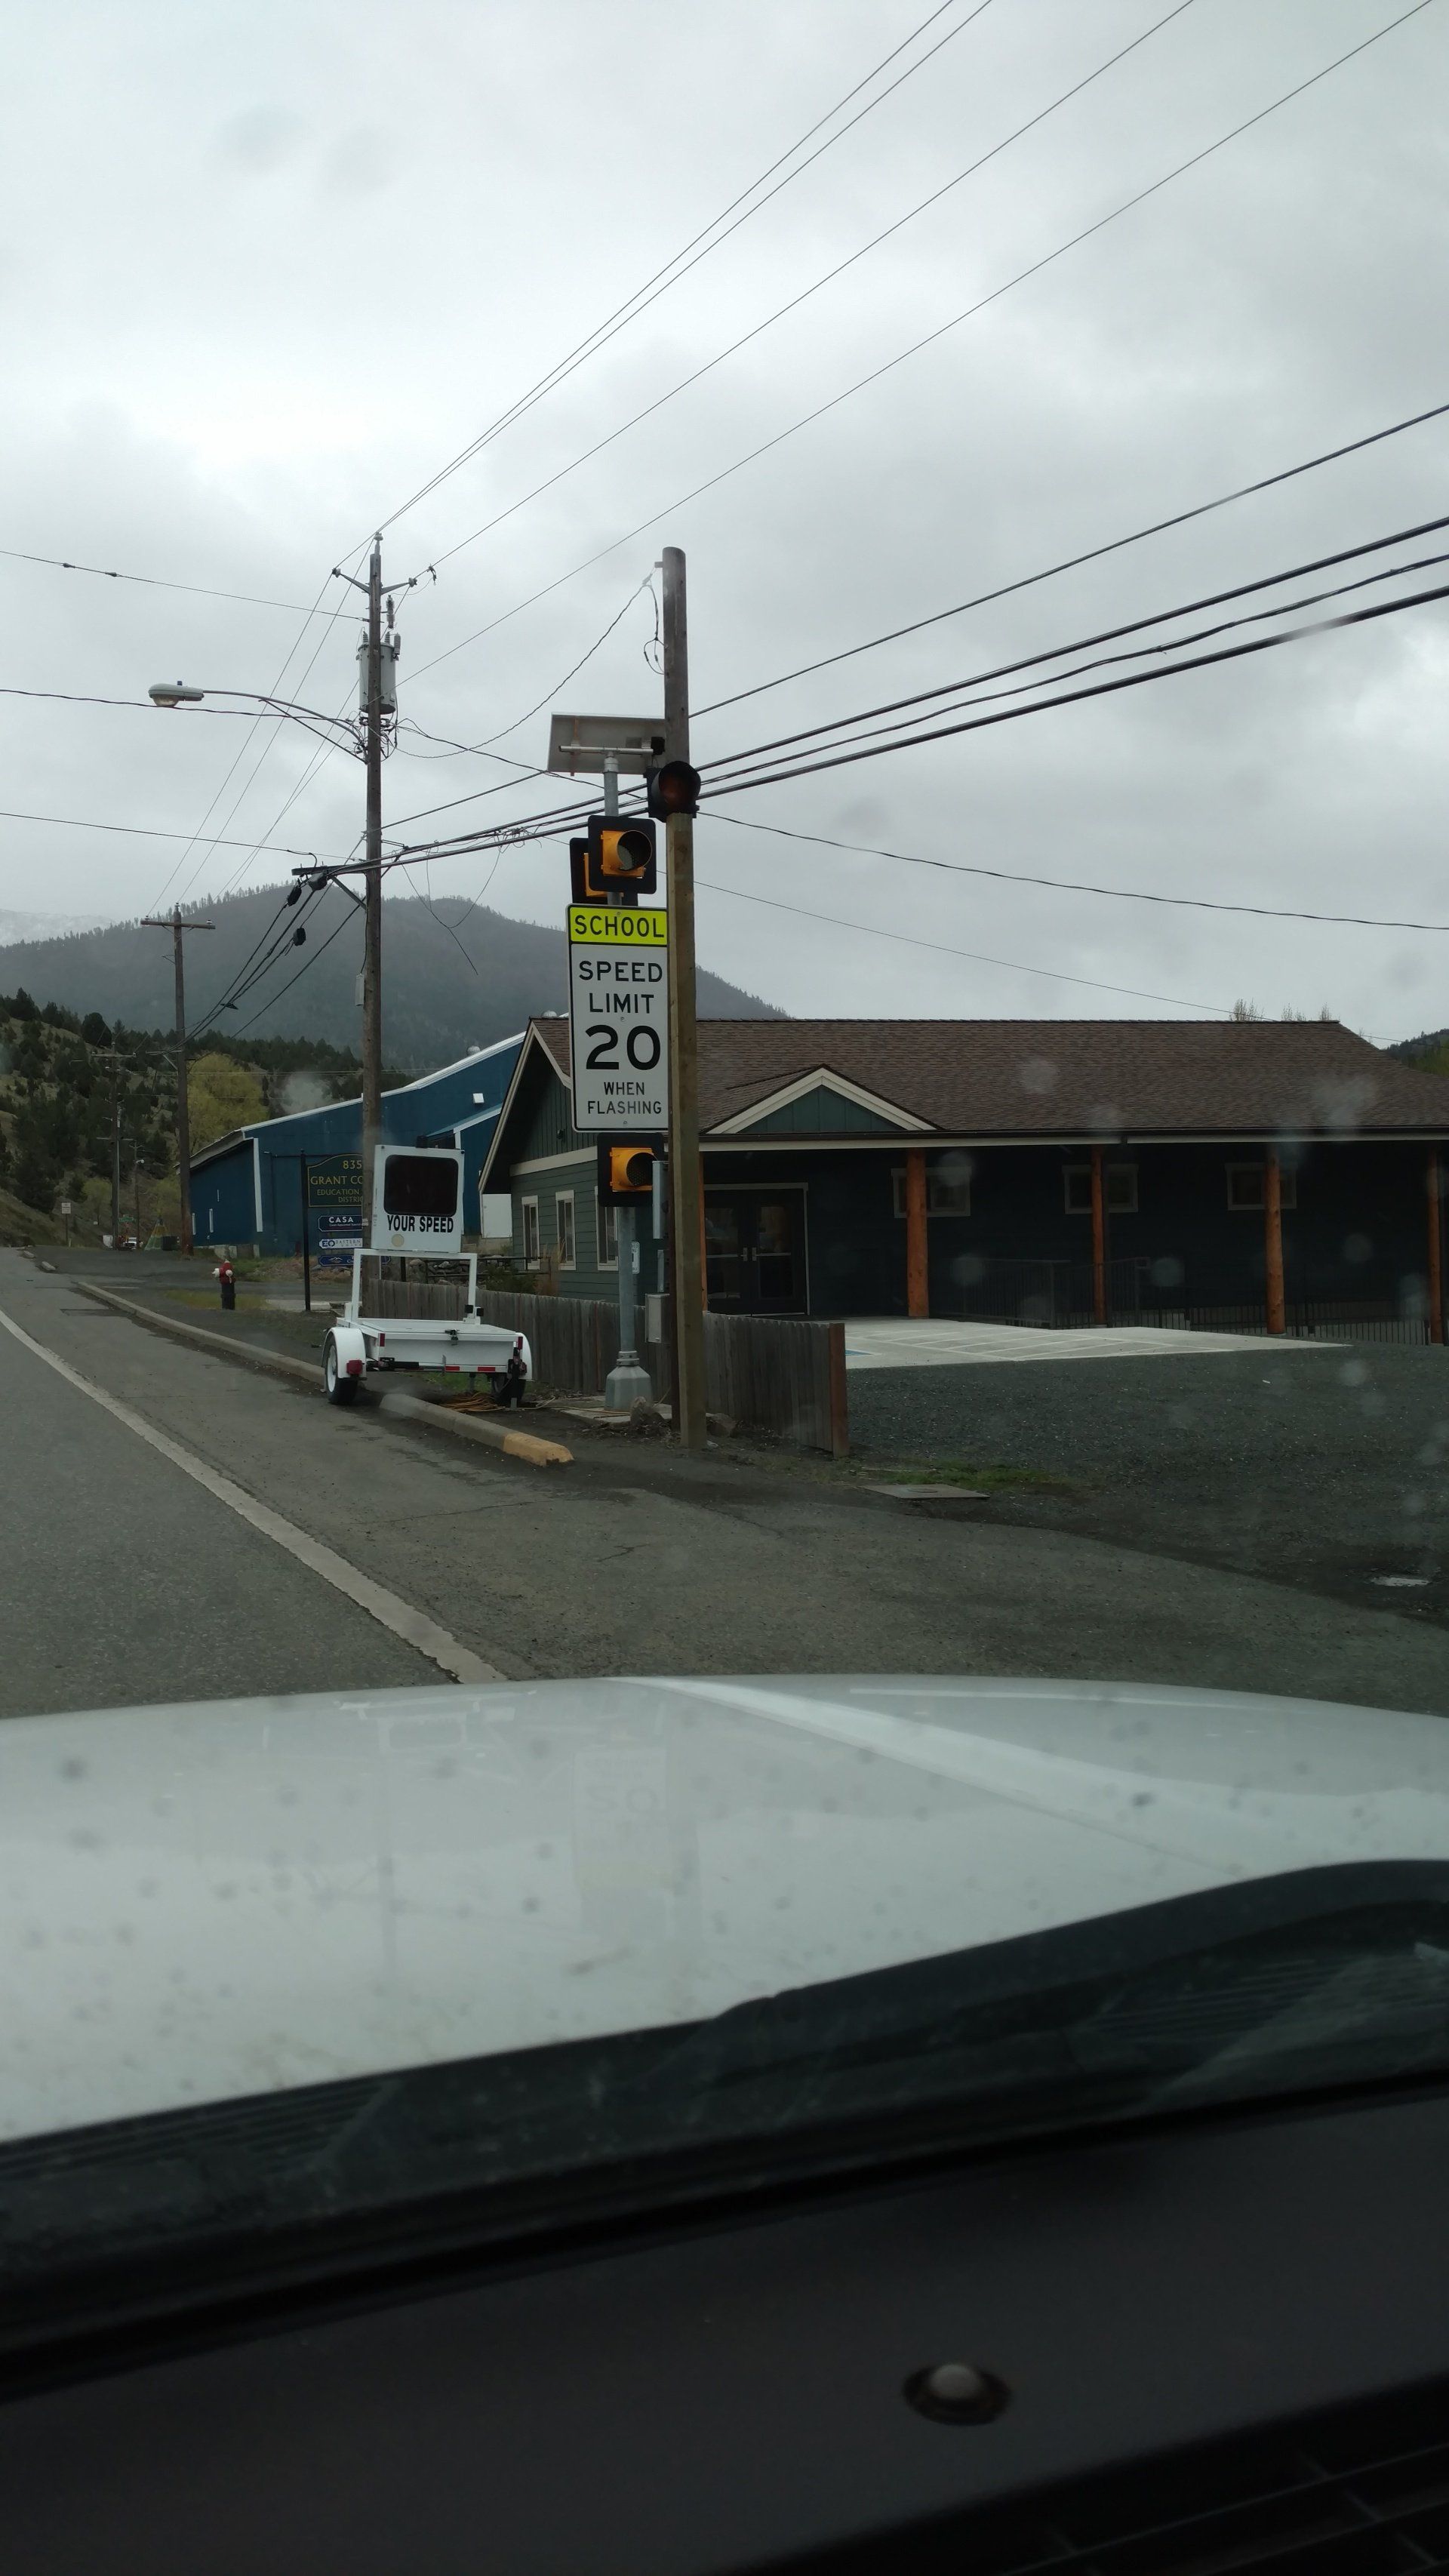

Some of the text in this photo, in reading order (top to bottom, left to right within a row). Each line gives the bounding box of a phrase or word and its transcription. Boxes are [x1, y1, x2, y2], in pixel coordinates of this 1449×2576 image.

[574, 914, 665, 938] SCHOOL
[579, 960, 663, 982] SPEED
[589, 993, 654, 1014] LIMIT
[585, 1024, 661, 1070] 20
[603, 1082, 645, 1096] WHEN
[587, 1100, 662, 1115] FLASHING
[343, 1160, 362, 1170] 835
[310, 1175, 348, 1185] GRANT
[387, 1214, 415, 1232] YOUR
[419, 1216, 454, 1233] SPEED
